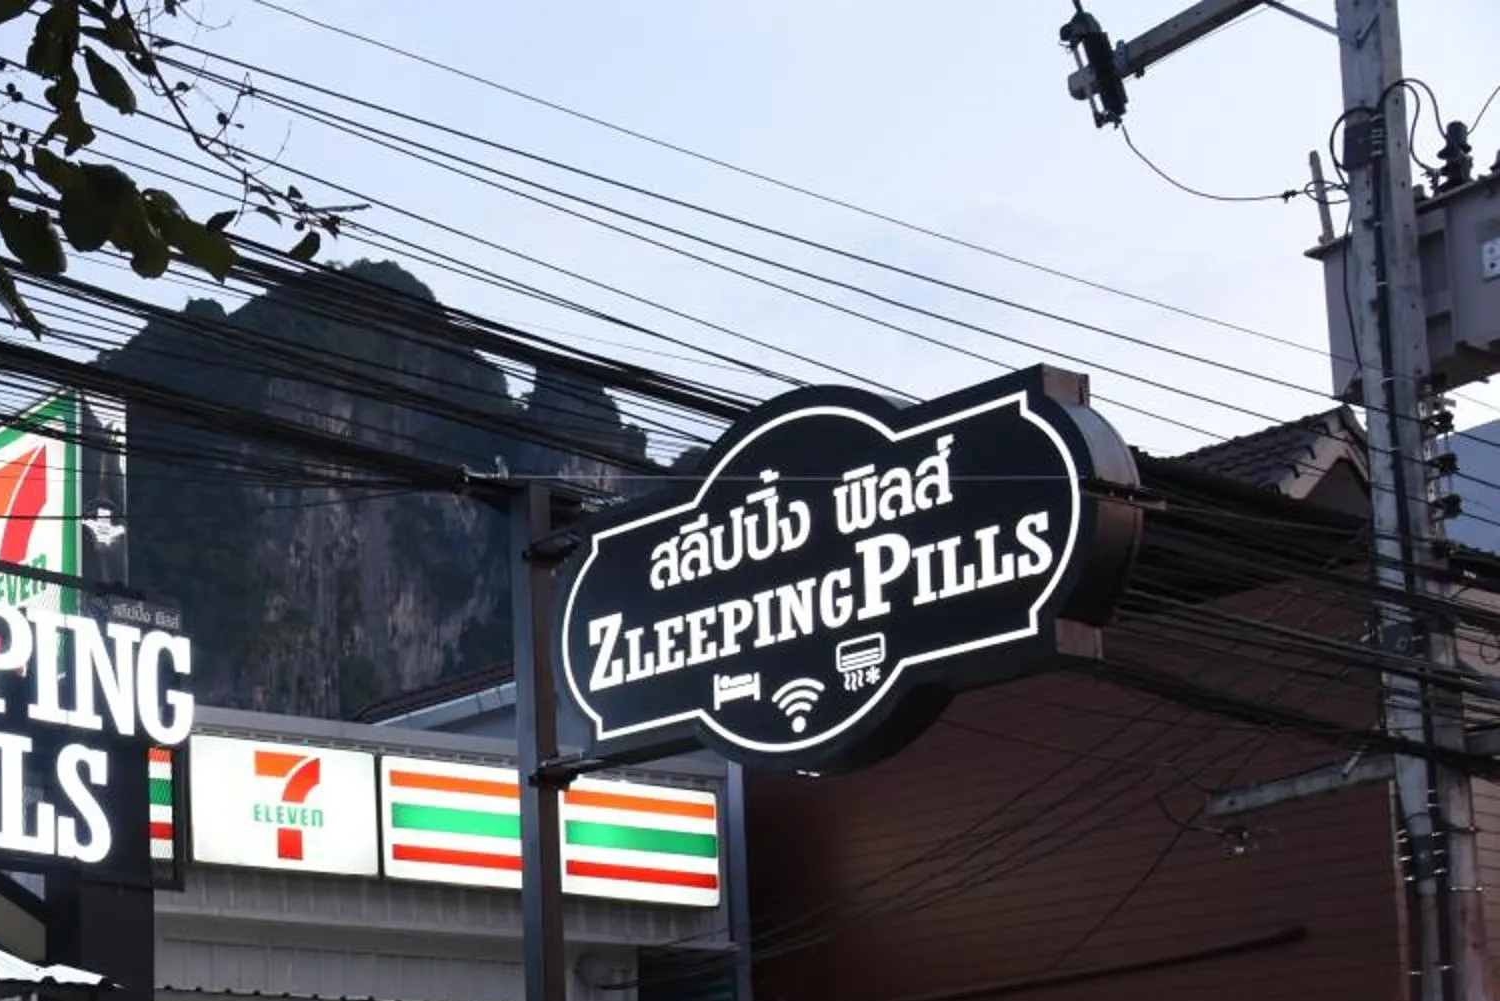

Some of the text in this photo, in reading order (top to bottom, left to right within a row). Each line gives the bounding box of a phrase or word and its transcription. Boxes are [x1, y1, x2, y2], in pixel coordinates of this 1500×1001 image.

[588, 511, 1053, 692] ZLEEPING PILLS
[253, 803, 323, 828] ELEVEN
[254, 751, 321, 860] 7
